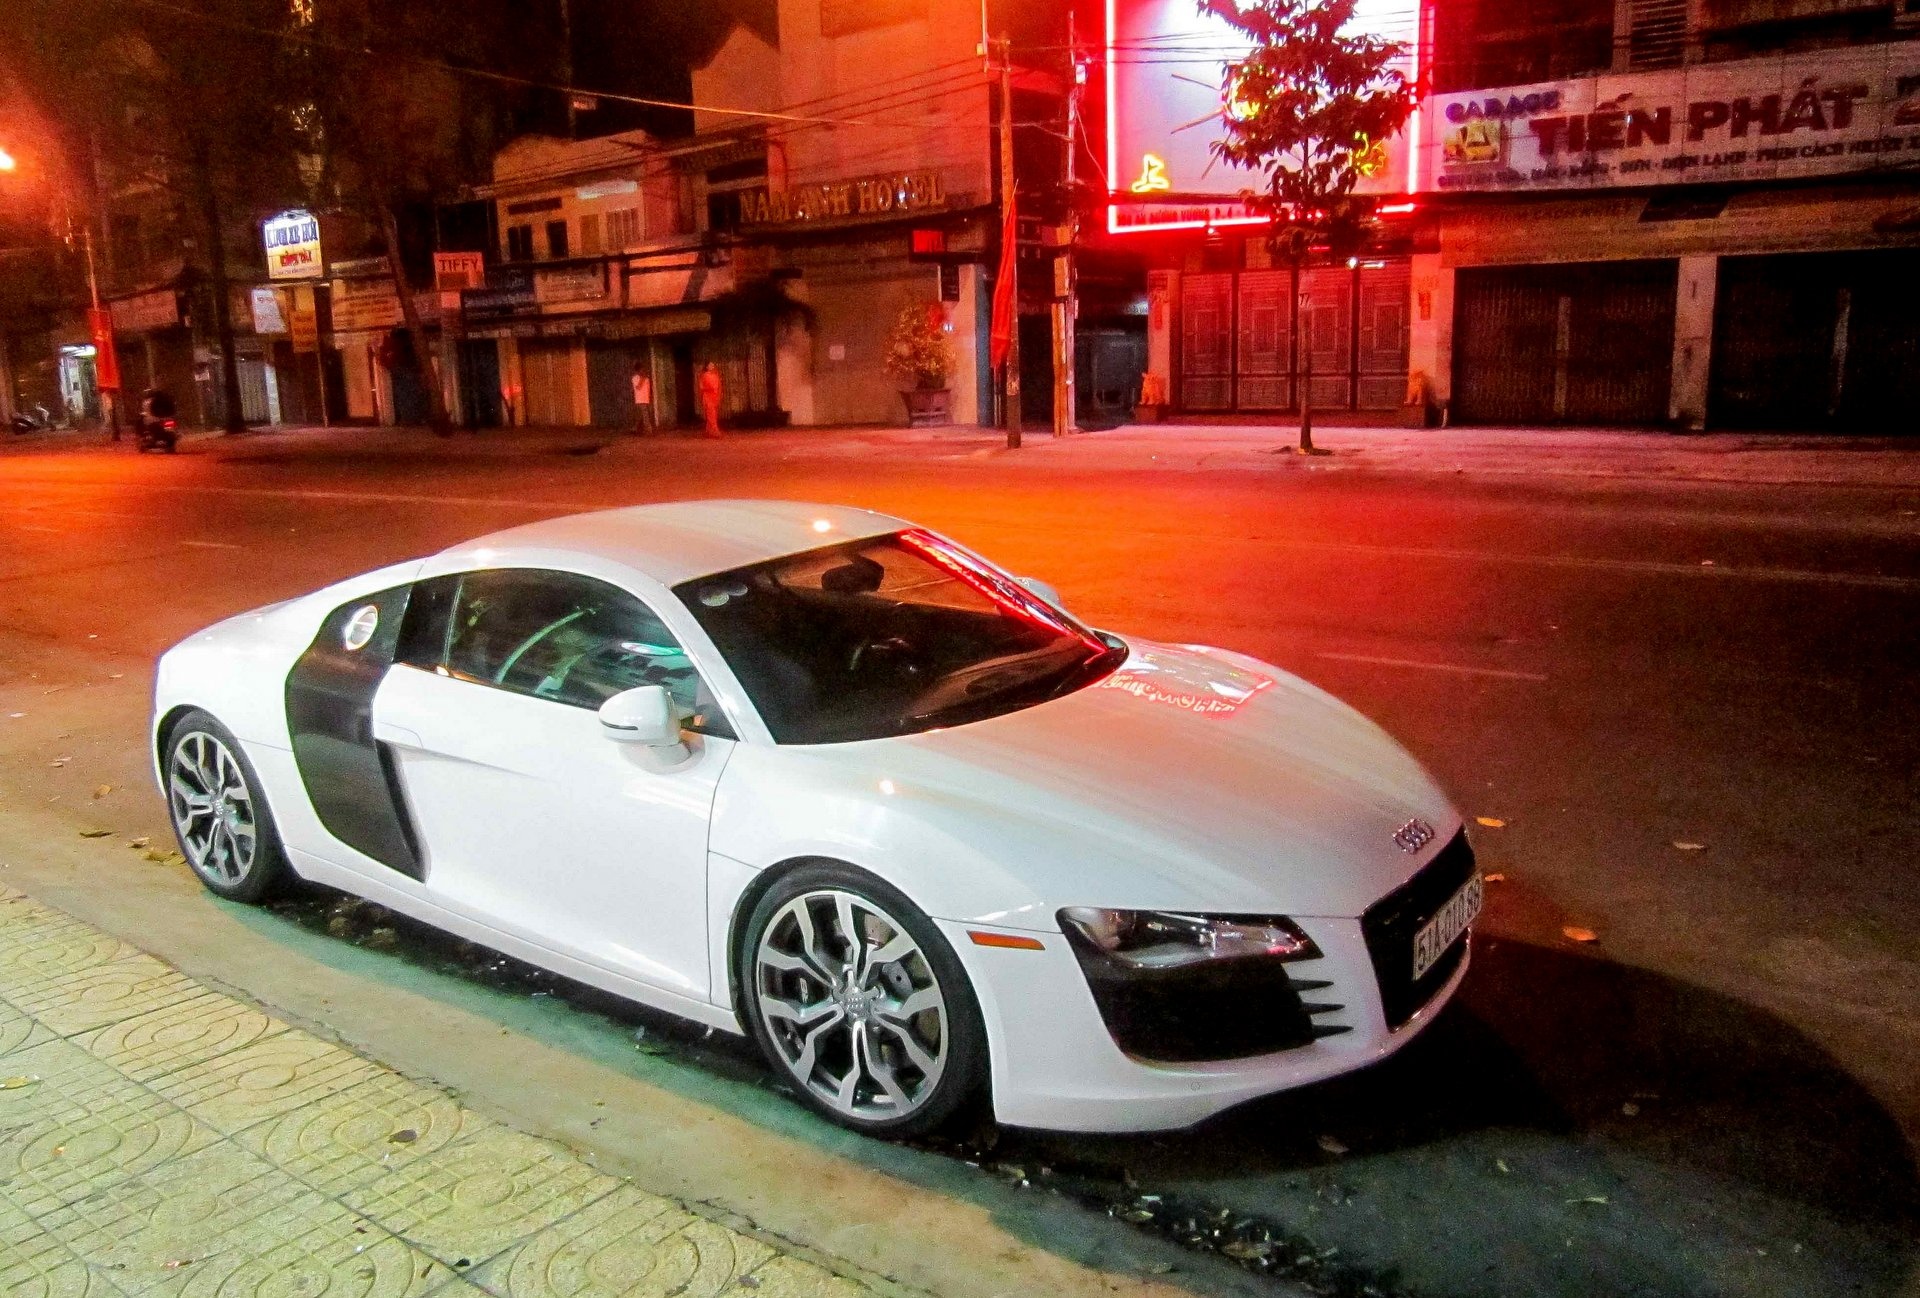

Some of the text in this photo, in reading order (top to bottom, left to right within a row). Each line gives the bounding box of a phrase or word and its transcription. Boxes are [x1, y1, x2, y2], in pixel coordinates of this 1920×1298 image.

[1529, 93, 1671, 156] TIẾN
[857, 174, 946, 214] HOTEL
[438, 257, 479, 273] TIFFY
